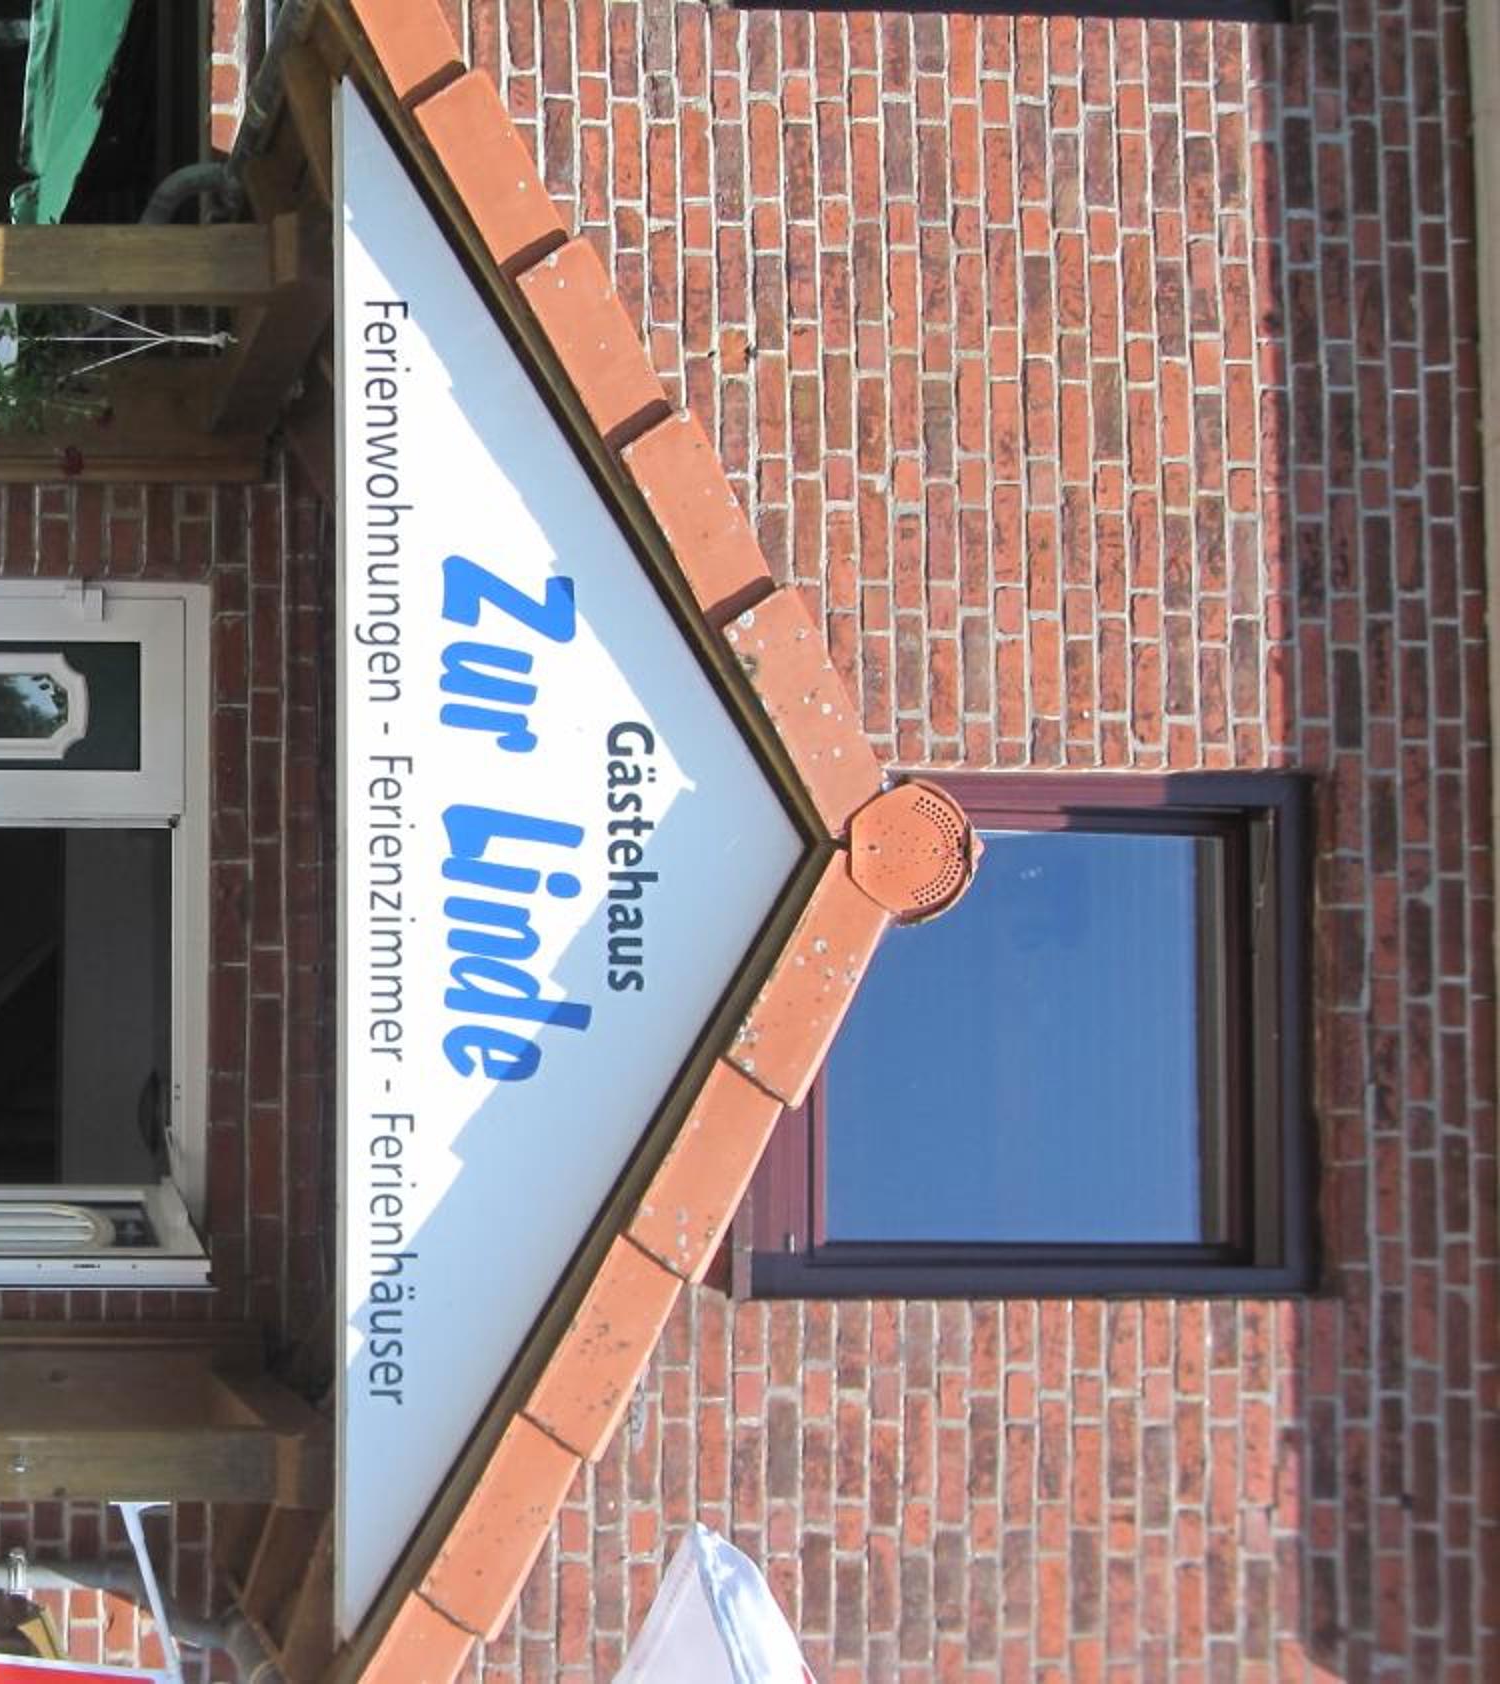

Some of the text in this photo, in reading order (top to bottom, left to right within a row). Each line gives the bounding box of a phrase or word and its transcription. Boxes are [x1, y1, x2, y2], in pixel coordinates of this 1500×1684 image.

[355, 299, 413, 702] Ferienwohnungen
[369, 755, 415, 1062] Ferienzimmer
[439, 554, 592, 1083] Zur Linde
[606, 721, 659, 993] Gästehaus
[369, 1113, 418, 1406] Ferienhäuser
